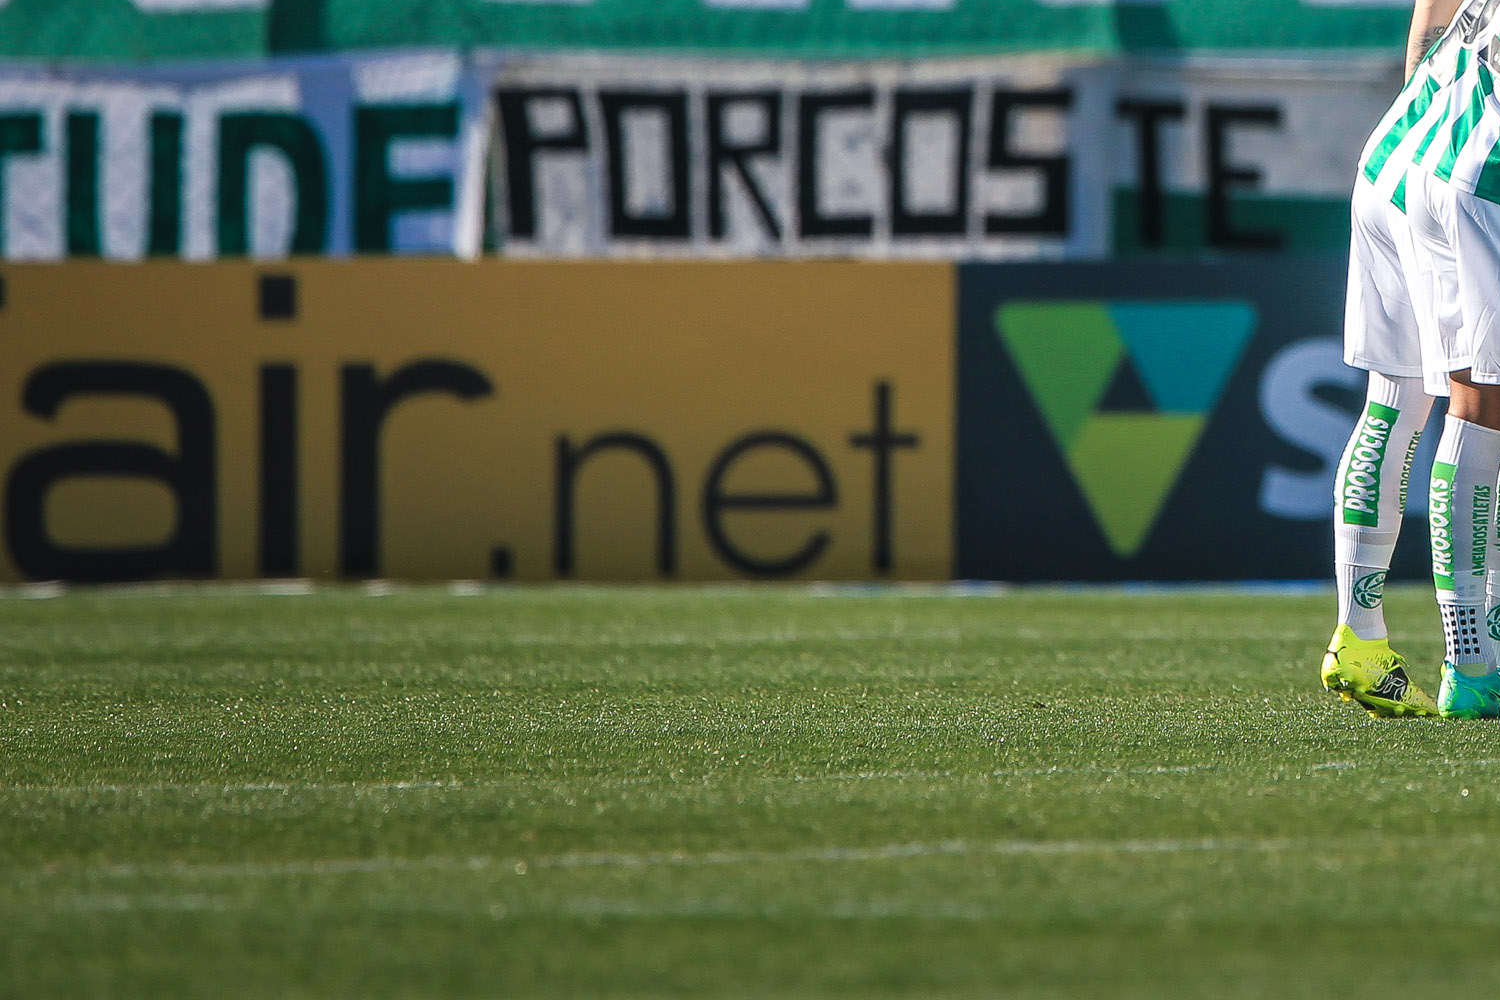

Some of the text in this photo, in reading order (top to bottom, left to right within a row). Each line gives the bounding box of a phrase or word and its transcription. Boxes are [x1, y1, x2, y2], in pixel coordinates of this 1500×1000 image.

[497, 86, 1288, 251] PORCOS TE
[0, 275, 920, 582] air.net
[1343, 414, 1391, 514] PROSOCKS
[1429, 475, 1452, 577] PROSOCKS
